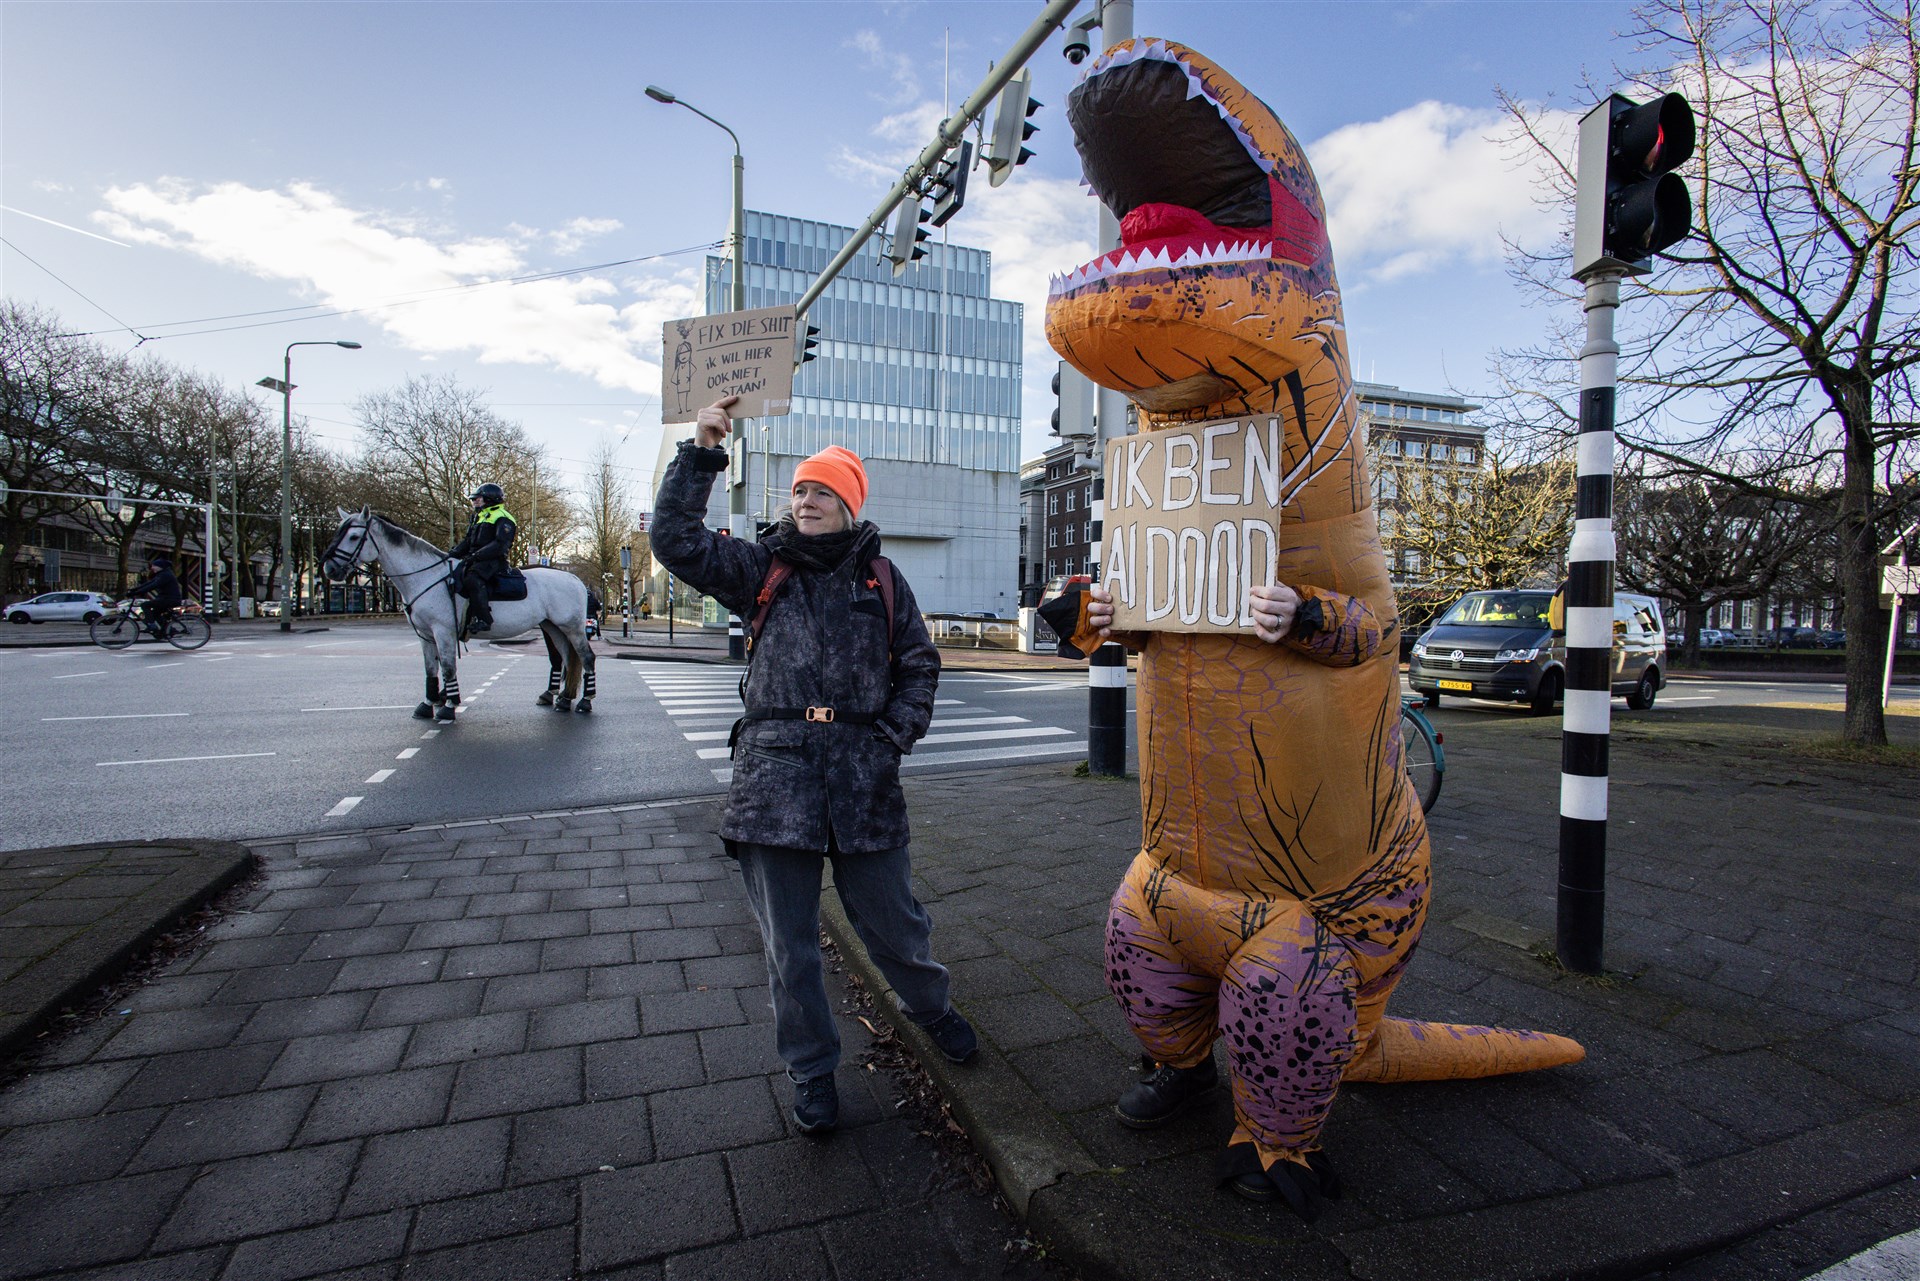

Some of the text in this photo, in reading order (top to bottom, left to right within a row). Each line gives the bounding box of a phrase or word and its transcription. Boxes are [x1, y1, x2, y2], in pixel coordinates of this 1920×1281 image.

[698, 316, 793, 345] FIX DIE SHIT
[721, 352, 741, 365] WIL
[744, 346, 772, 360] HIER
[707, 366, 762, 389] OOK NIET
[721, 378, 766, 398] STAAN!
[1109, 417, 1280, 512] IK BEN
[1145, 517, 1278, 629] DOOD
